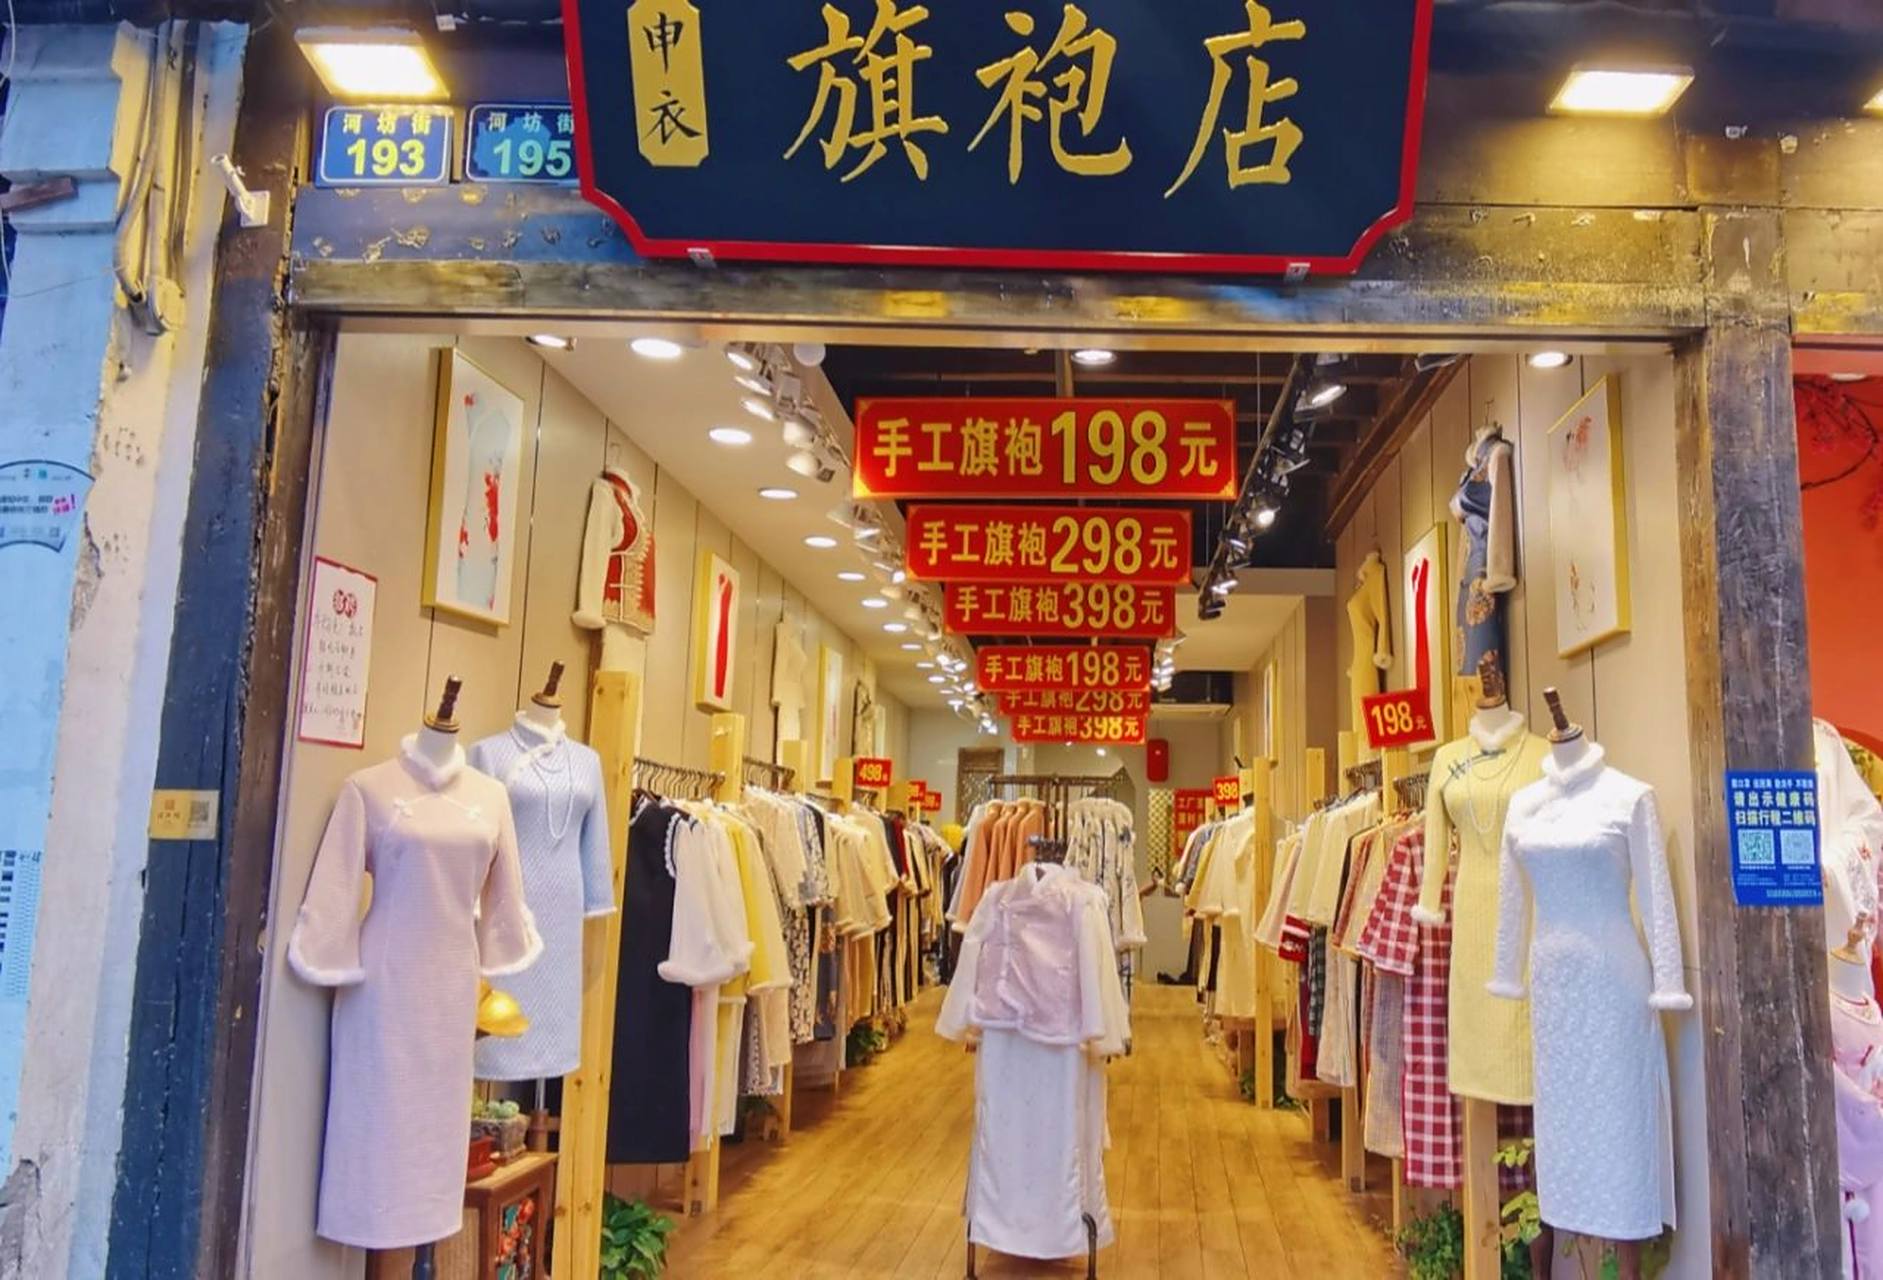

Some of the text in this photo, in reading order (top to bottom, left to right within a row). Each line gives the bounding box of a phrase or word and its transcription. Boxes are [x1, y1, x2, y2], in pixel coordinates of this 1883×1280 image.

[642, 12, 702, 145] 申衣
[783, 0, 1307, 198] 旗袍店
[343, 112, 431, 135] 河坊街
[488, 112, 574, 135] 河坊街
[347, 138, 425, 175] 193
[493, 139, 571, 176] 195
[873, 409, 1217, 485] 手工旗袍198元
[919, 516, 1178, 575] 手工旗袍298元
[954, 582, 1164, 630] 手工旗袍398元
[985, 651, 1142, 686] 手工旗袍198元
